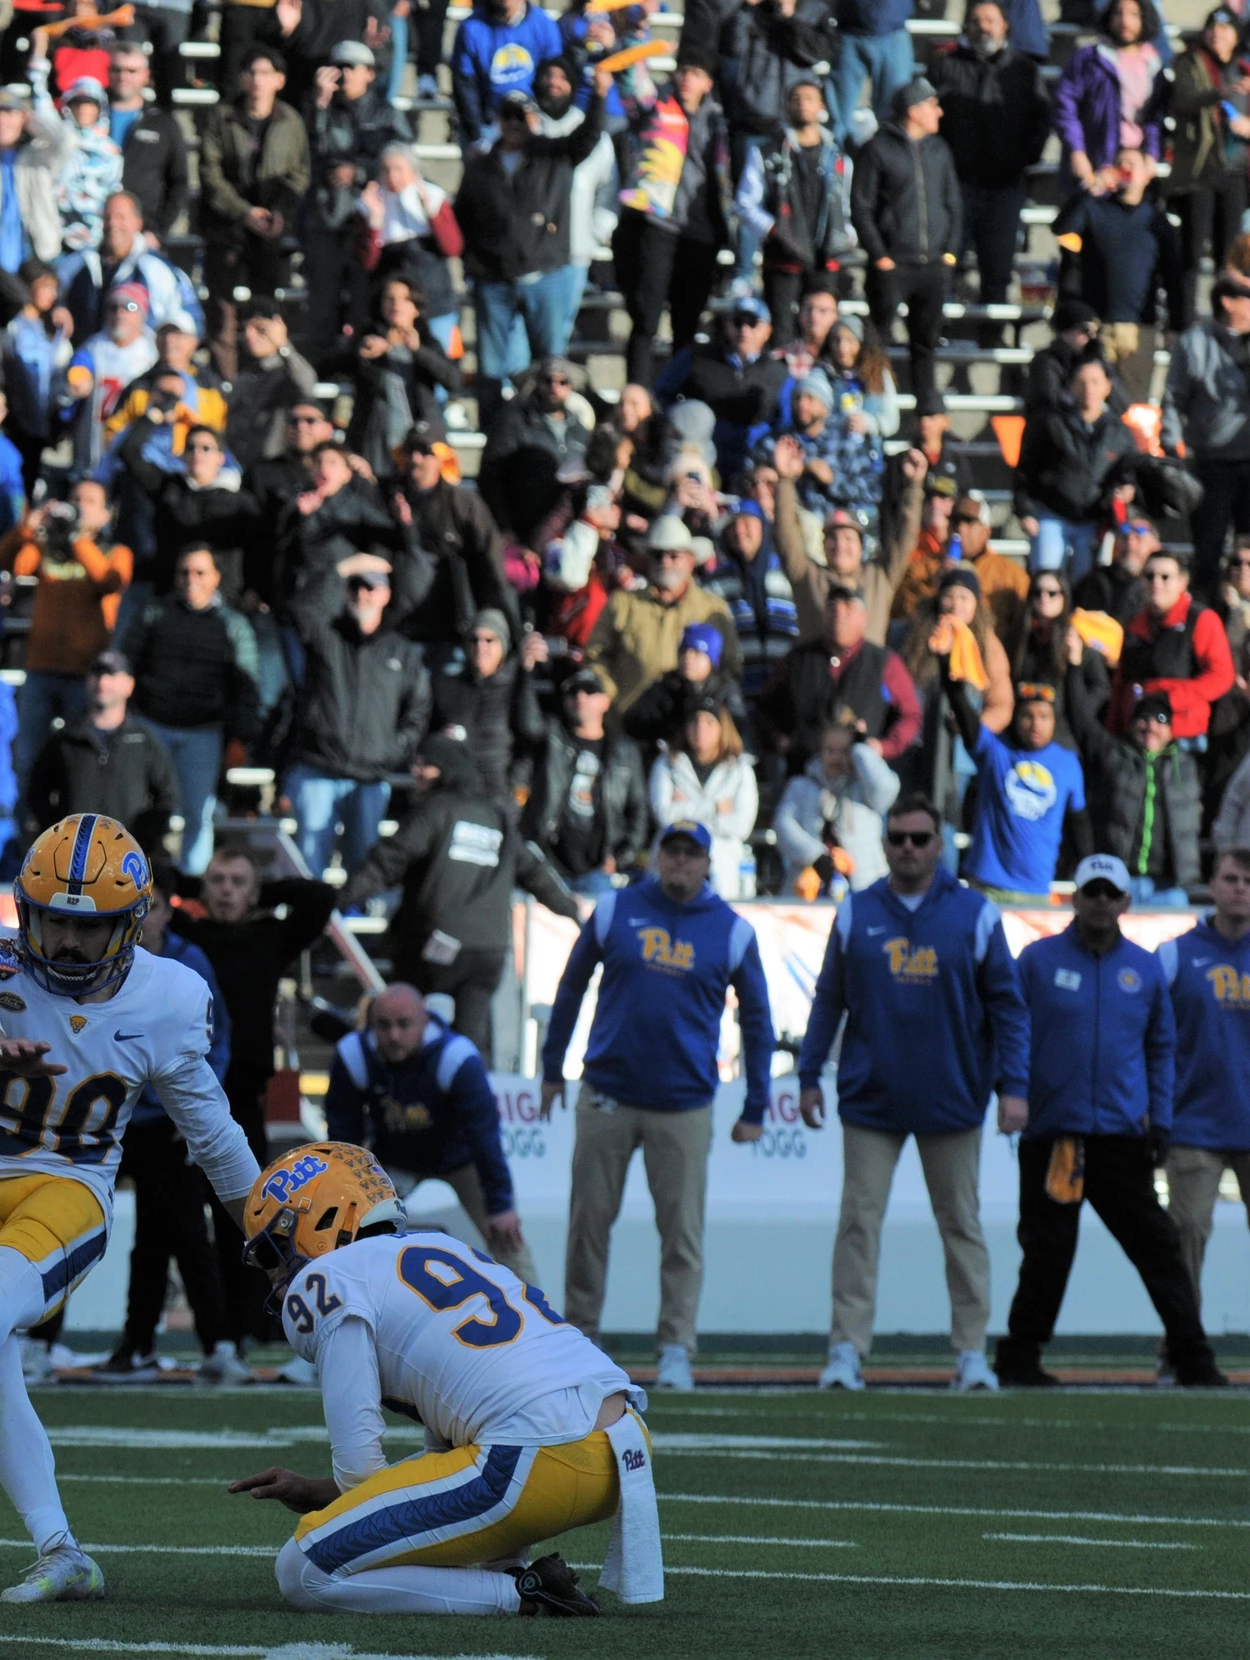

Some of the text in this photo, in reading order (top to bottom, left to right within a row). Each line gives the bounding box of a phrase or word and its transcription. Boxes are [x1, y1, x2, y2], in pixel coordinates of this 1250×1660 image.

[637, 926, 695, 970] Pitt
[883, 936, 938, 976] Pitt
[261, 1155, 328, 1203] Pitt
[287, 1273, 342, 1335] 92
[621, 1449, 646, 1472] Pitt
